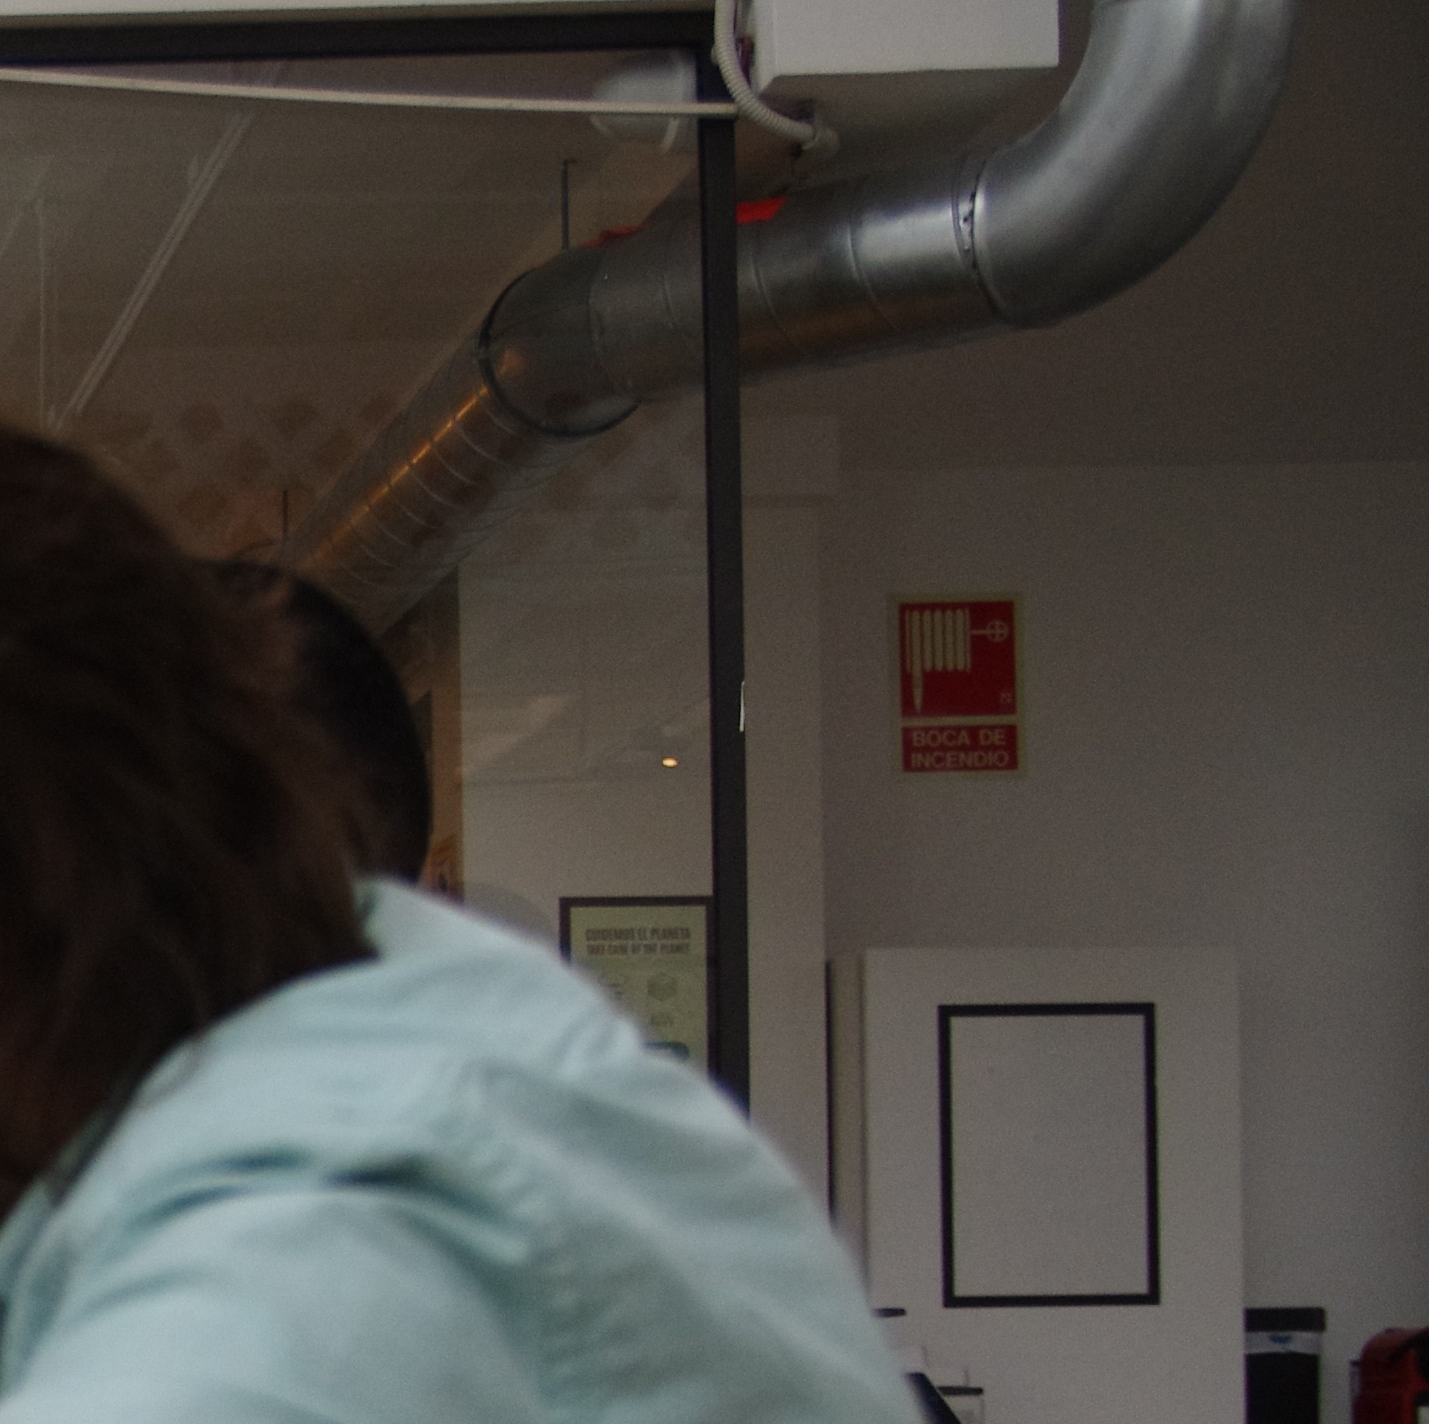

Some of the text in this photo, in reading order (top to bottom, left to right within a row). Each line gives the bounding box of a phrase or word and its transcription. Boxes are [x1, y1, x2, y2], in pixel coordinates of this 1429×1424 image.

[913, 728, 1006, 747] BOCA DE
[911, 750, 1009, 769] INCENDIO
[649, 926, 691, 940] PLANETA
